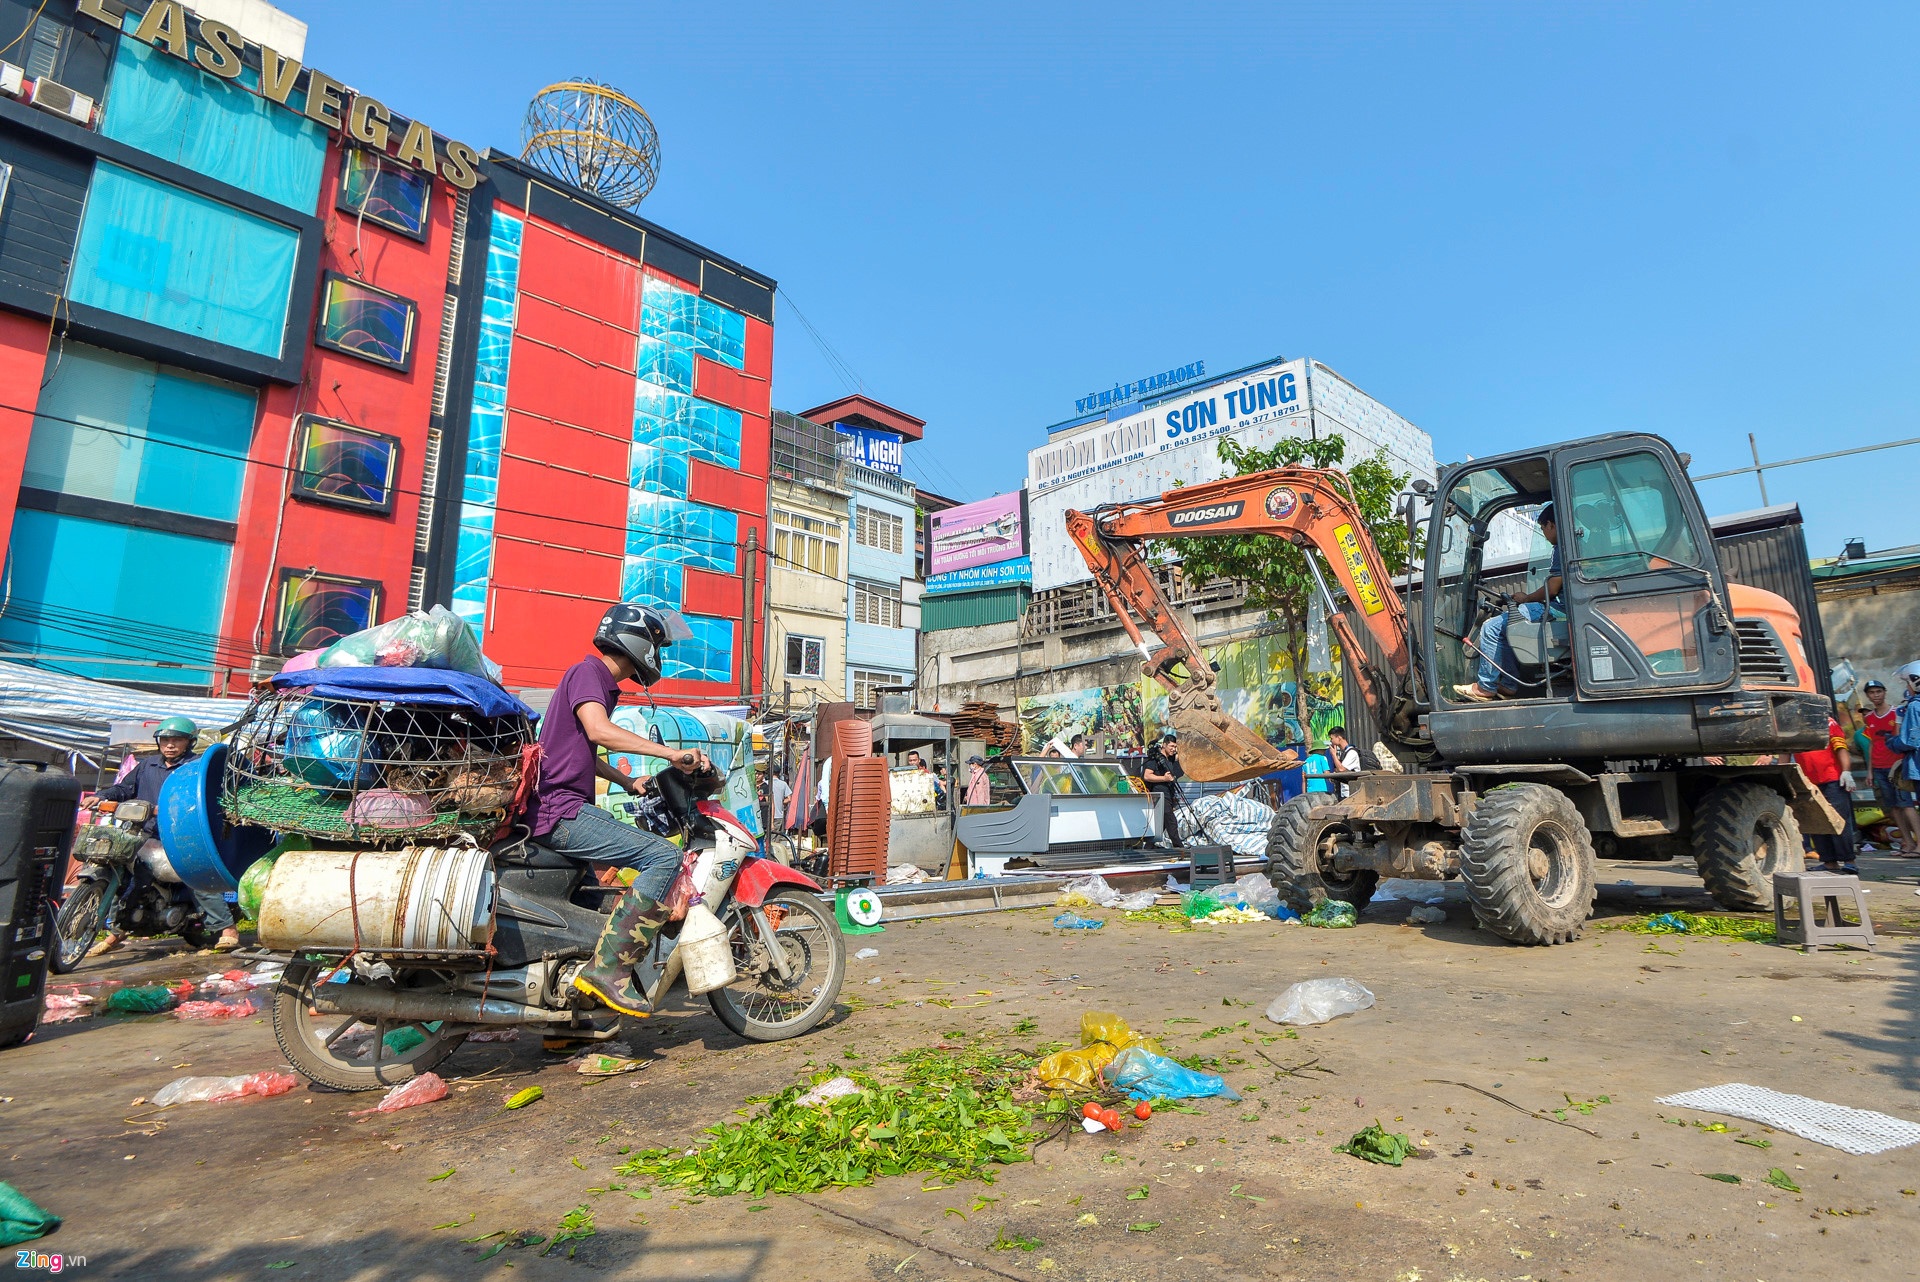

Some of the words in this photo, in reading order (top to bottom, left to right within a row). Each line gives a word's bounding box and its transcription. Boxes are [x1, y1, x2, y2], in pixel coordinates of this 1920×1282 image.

[260, 43, 479, 190] VEGAS
[1034, 437, 1096, 481] NHÔM
[1101, 418, 1156, 460] KÍNH
[1166, 397, 1217, 438] SƠN
[1223, 373, 1297, 420] TÙNG
[1174, 438, 1189, 448] 043
[1209, 426, 1230, 437] 5400
[1252, 413, 1269, 424] 377
[1272, 404, 1300, 418] 18791
[1174, 504, 1238, 524] DOOSAN
[949, 571, 957, 580] TY
[958, 567, 980, 580] NHÔM
[981, 566, 998, 578] KÍNH
[999, 566, 1015, 577] SƠN
